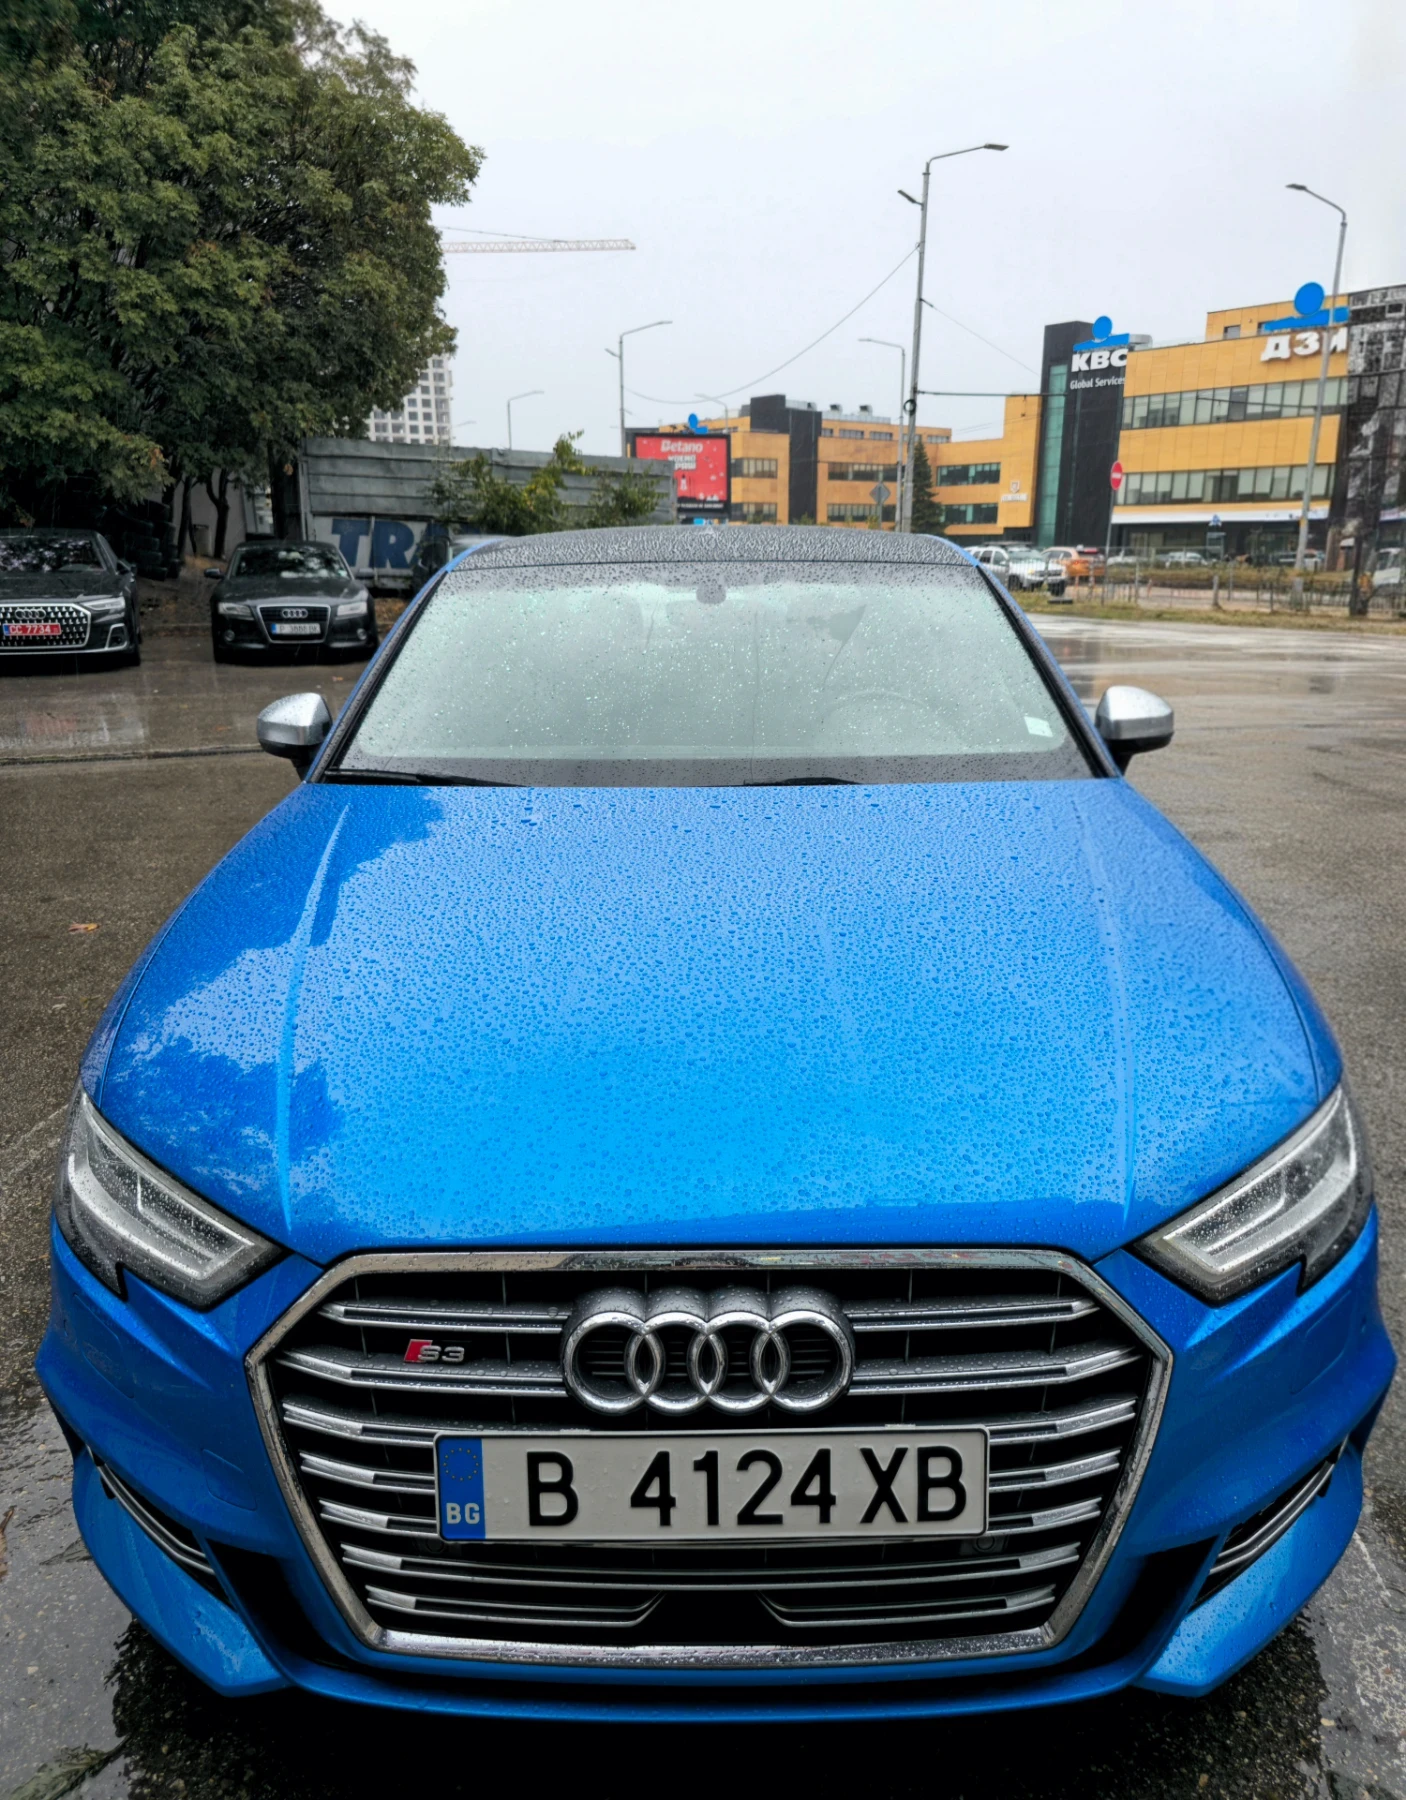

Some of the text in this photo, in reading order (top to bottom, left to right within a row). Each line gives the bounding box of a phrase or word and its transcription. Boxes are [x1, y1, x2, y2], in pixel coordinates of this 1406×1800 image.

[1260, 326, 1349, 362] ДЗИ
[1071, 348, 1129, 372] KBC
[1070, 378, 1094, 390] Global
[661, 439, 704, 453] Betano
[417, 1344, 465, 1362] S3
[526, 1445, 967, 1527] B 4124 XB
[446, 1502, 481, 1525] BG
